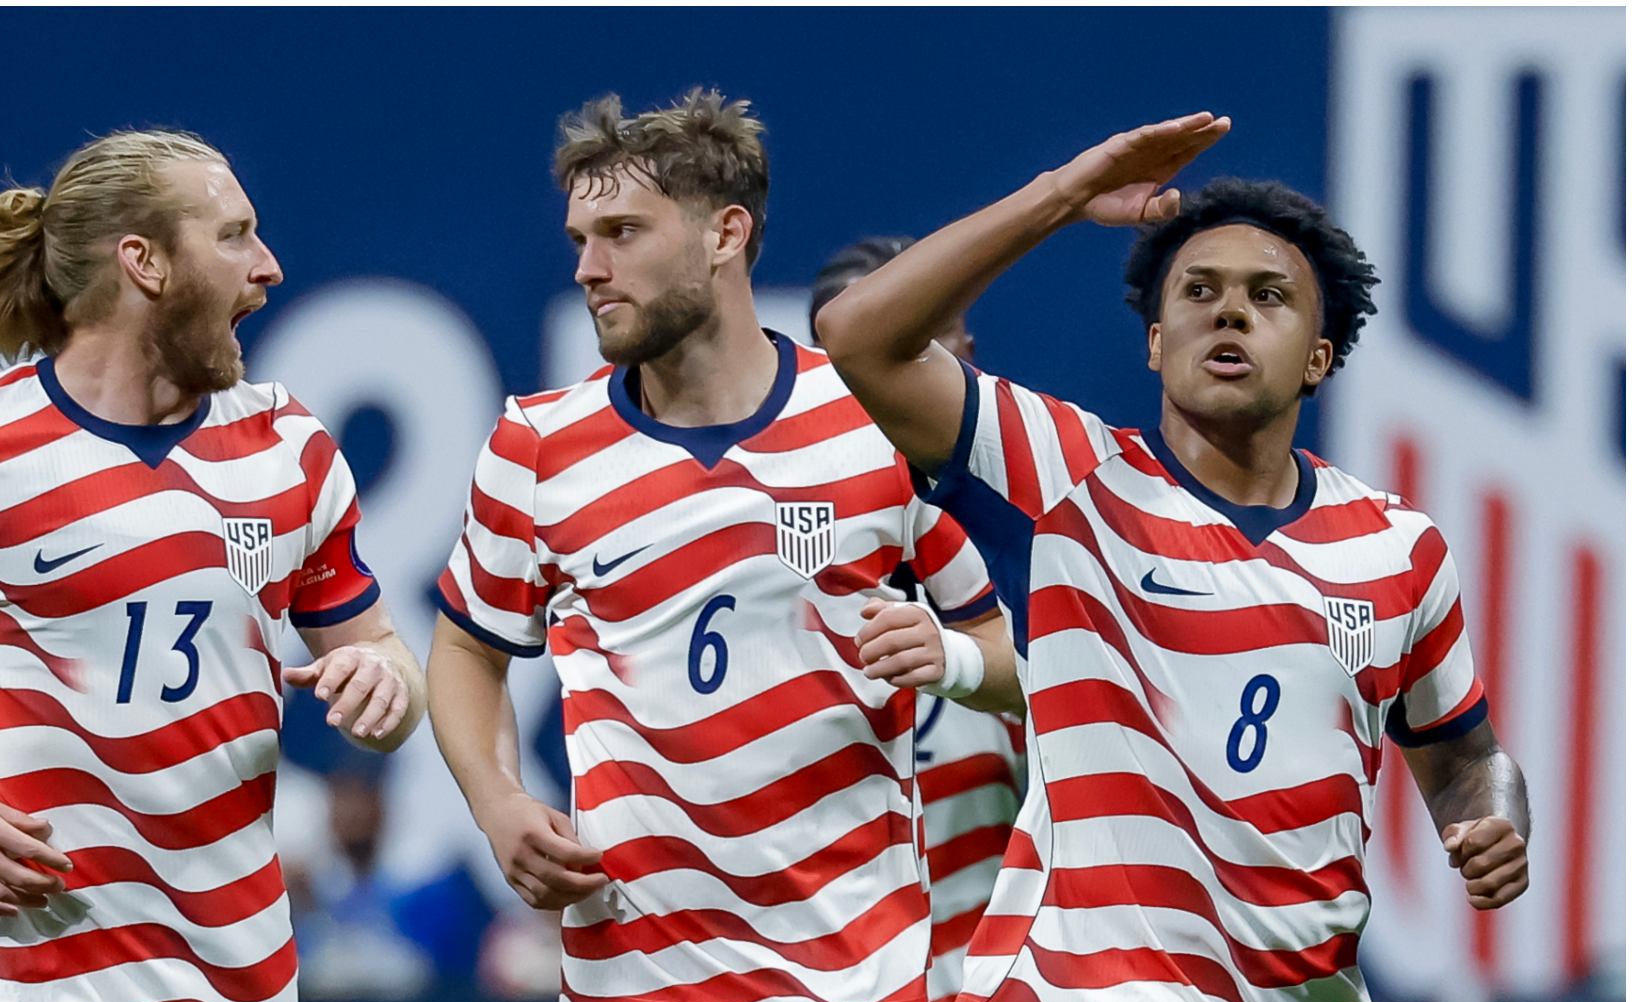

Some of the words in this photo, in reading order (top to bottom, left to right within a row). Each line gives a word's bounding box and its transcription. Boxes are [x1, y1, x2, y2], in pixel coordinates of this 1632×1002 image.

[227, 522, 269, 551] USA
[780, 506, 830, 535] USA
[688, 594, 737, 695] 6
[1328, 600, 1370, 631] USA
[116, 600, 213, 704] 13
[1226, 673, 1281, 774] 8
